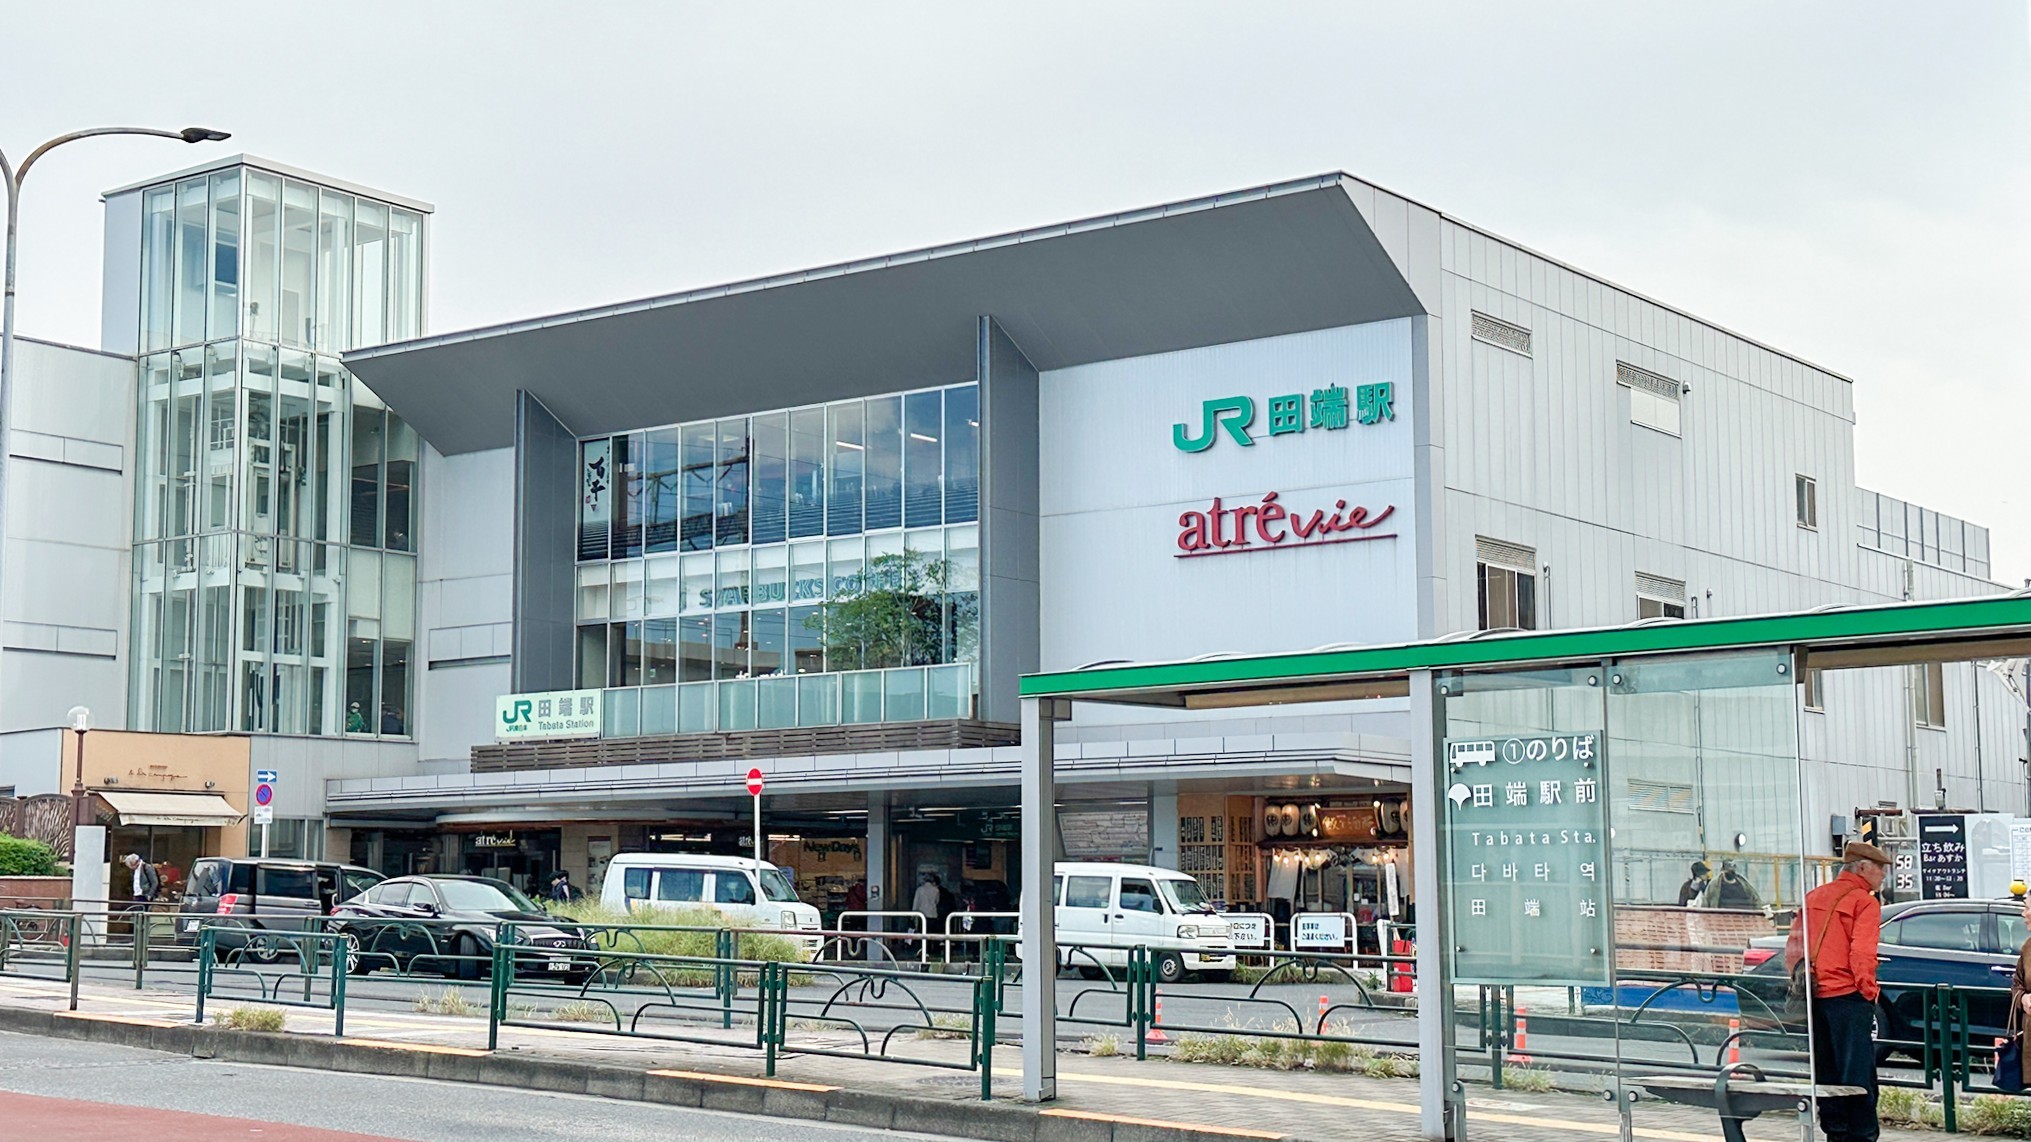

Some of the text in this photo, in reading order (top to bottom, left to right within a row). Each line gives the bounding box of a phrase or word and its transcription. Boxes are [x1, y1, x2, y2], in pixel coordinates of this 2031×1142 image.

[1173, 381, 1395, 453] JR 田端駅
[503, 696, 594, 724] JR 田端駅
[538, 720, 564, 731] Tabata
[565, 719, 594, 730] Station
[1472, 777, 1597, 807] 田端駅前
[1472, 829, 1596, 846] Tabata Sta.
[1921, 842, 1965, 853] 立ち飲み
[1895, 854, 1913, 870] 58
[1896, 874, 1913, 889] 35
[1471, 898, 1596, 918] 田端站
